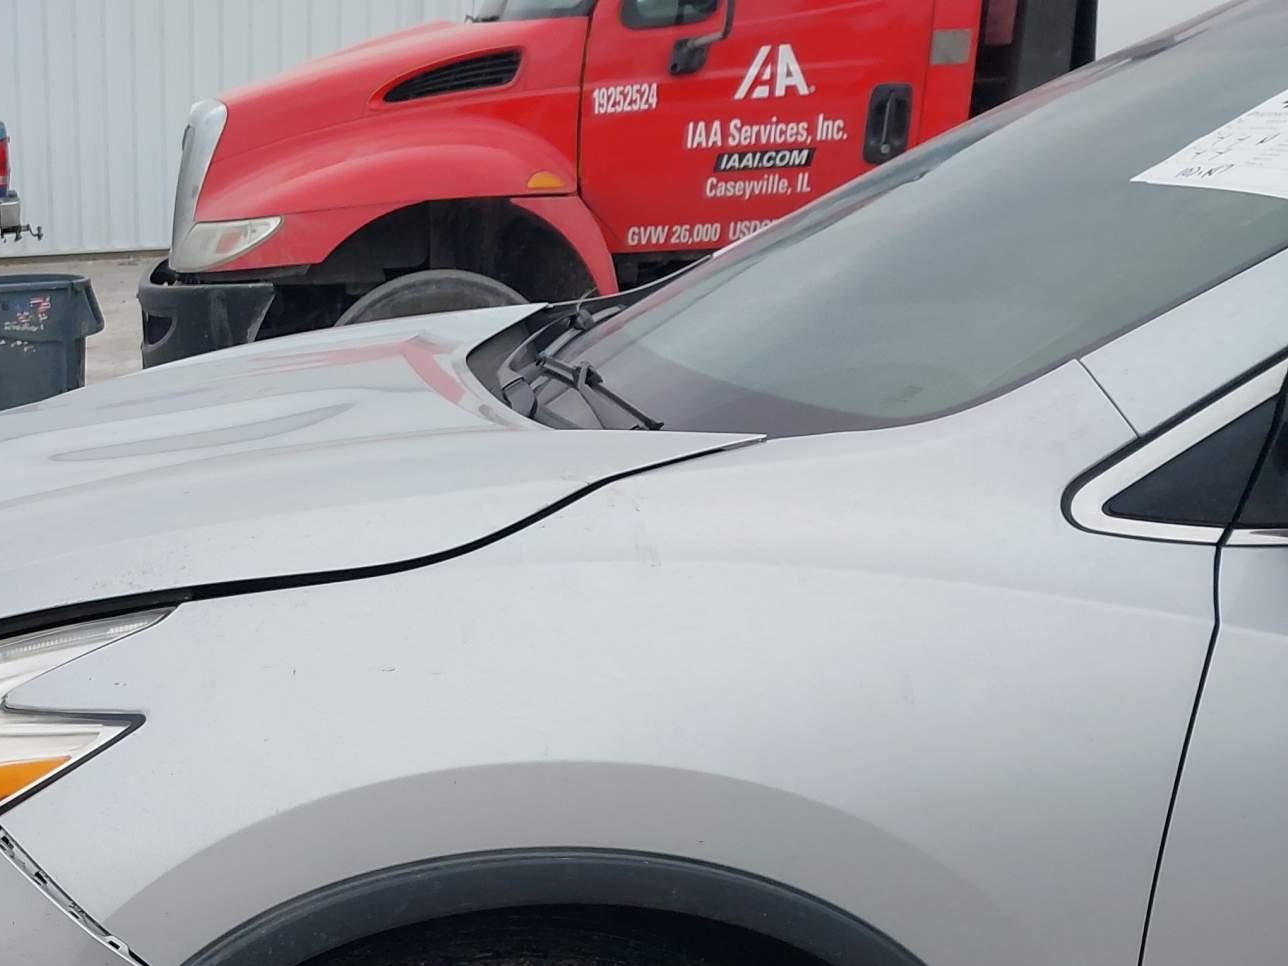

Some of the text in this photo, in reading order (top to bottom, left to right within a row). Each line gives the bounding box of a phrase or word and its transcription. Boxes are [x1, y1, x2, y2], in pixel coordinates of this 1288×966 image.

[593, 82, 658, 114] 19252524
[686, 113, 848, 149] IAA Services, Inc.
[720, 149, 809, 170] IAAI.COM
[705, 172, 811, 199] Caseyville, IL
[627, 225, 669, 246] GVW
[670, 223, 721, 244] 26,000
